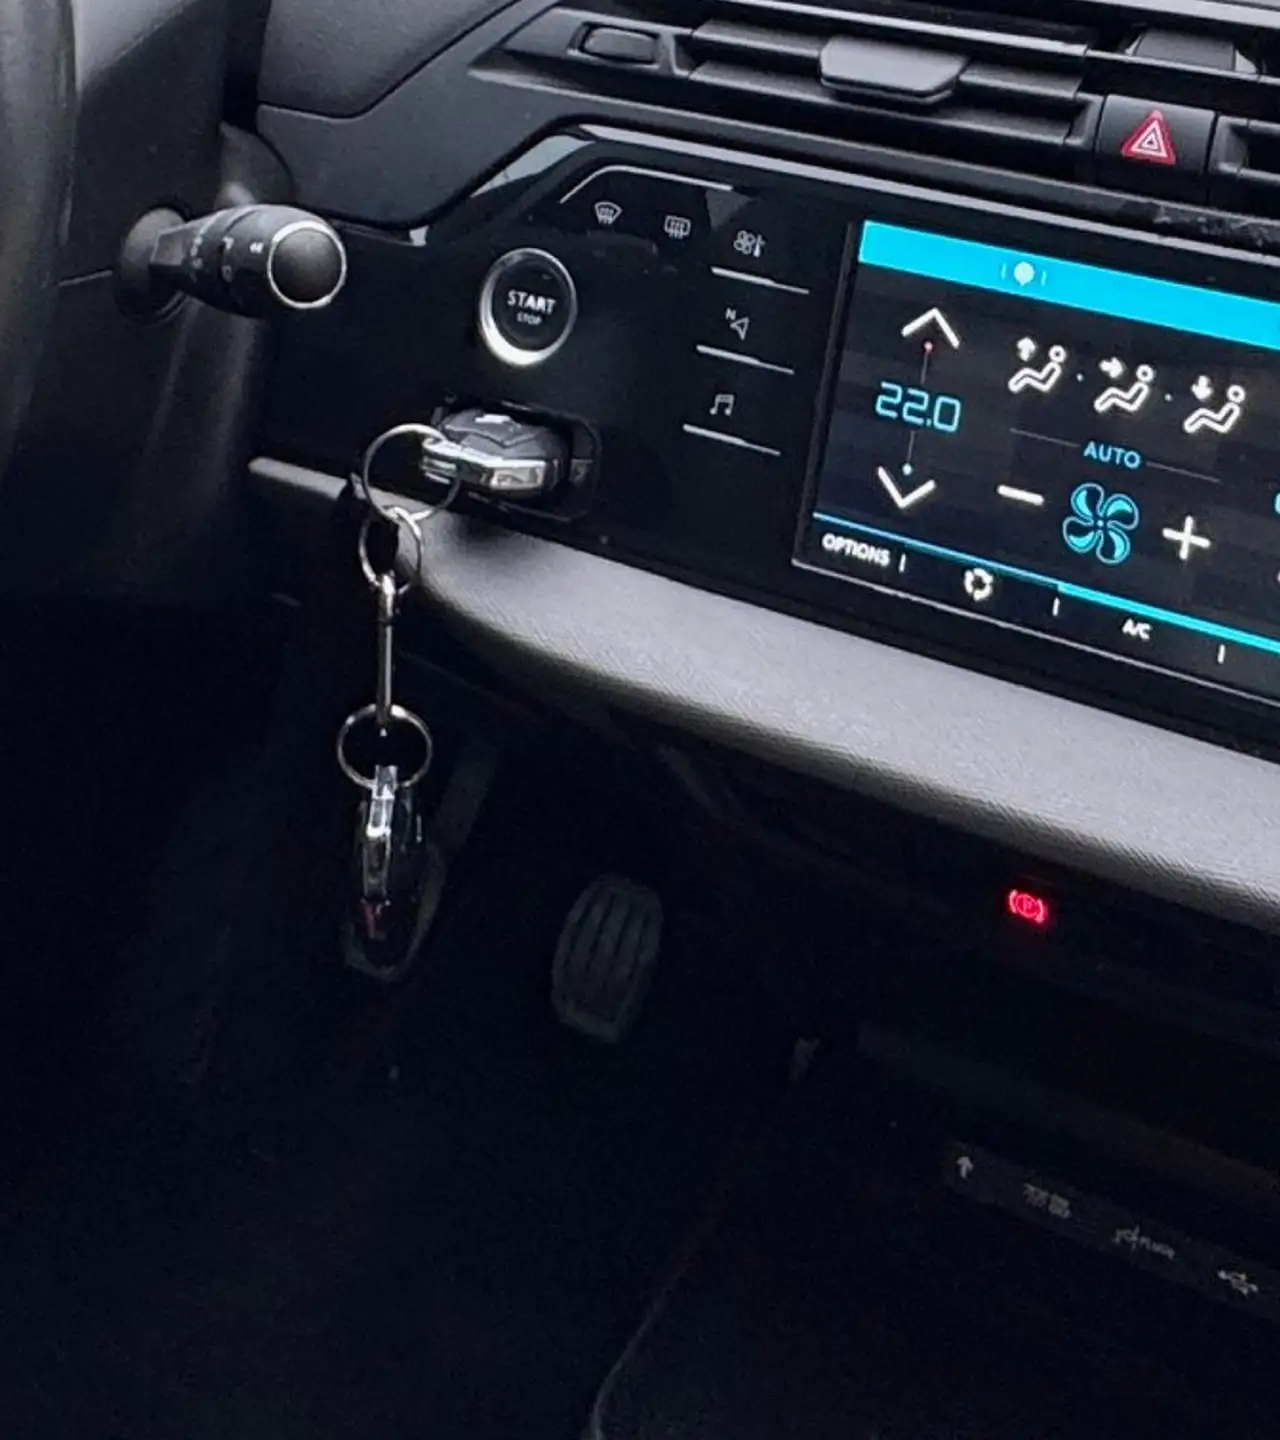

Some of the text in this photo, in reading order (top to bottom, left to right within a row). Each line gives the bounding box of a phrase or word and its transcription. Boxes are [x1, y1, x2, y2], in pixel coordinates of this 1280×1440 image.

[506, 288, 557, 316] START
[875, 380, 962, 433] 22.0
[1083, 440, 1142, 470] AUTO
[821, 532, 891, 568] OPTIONS
